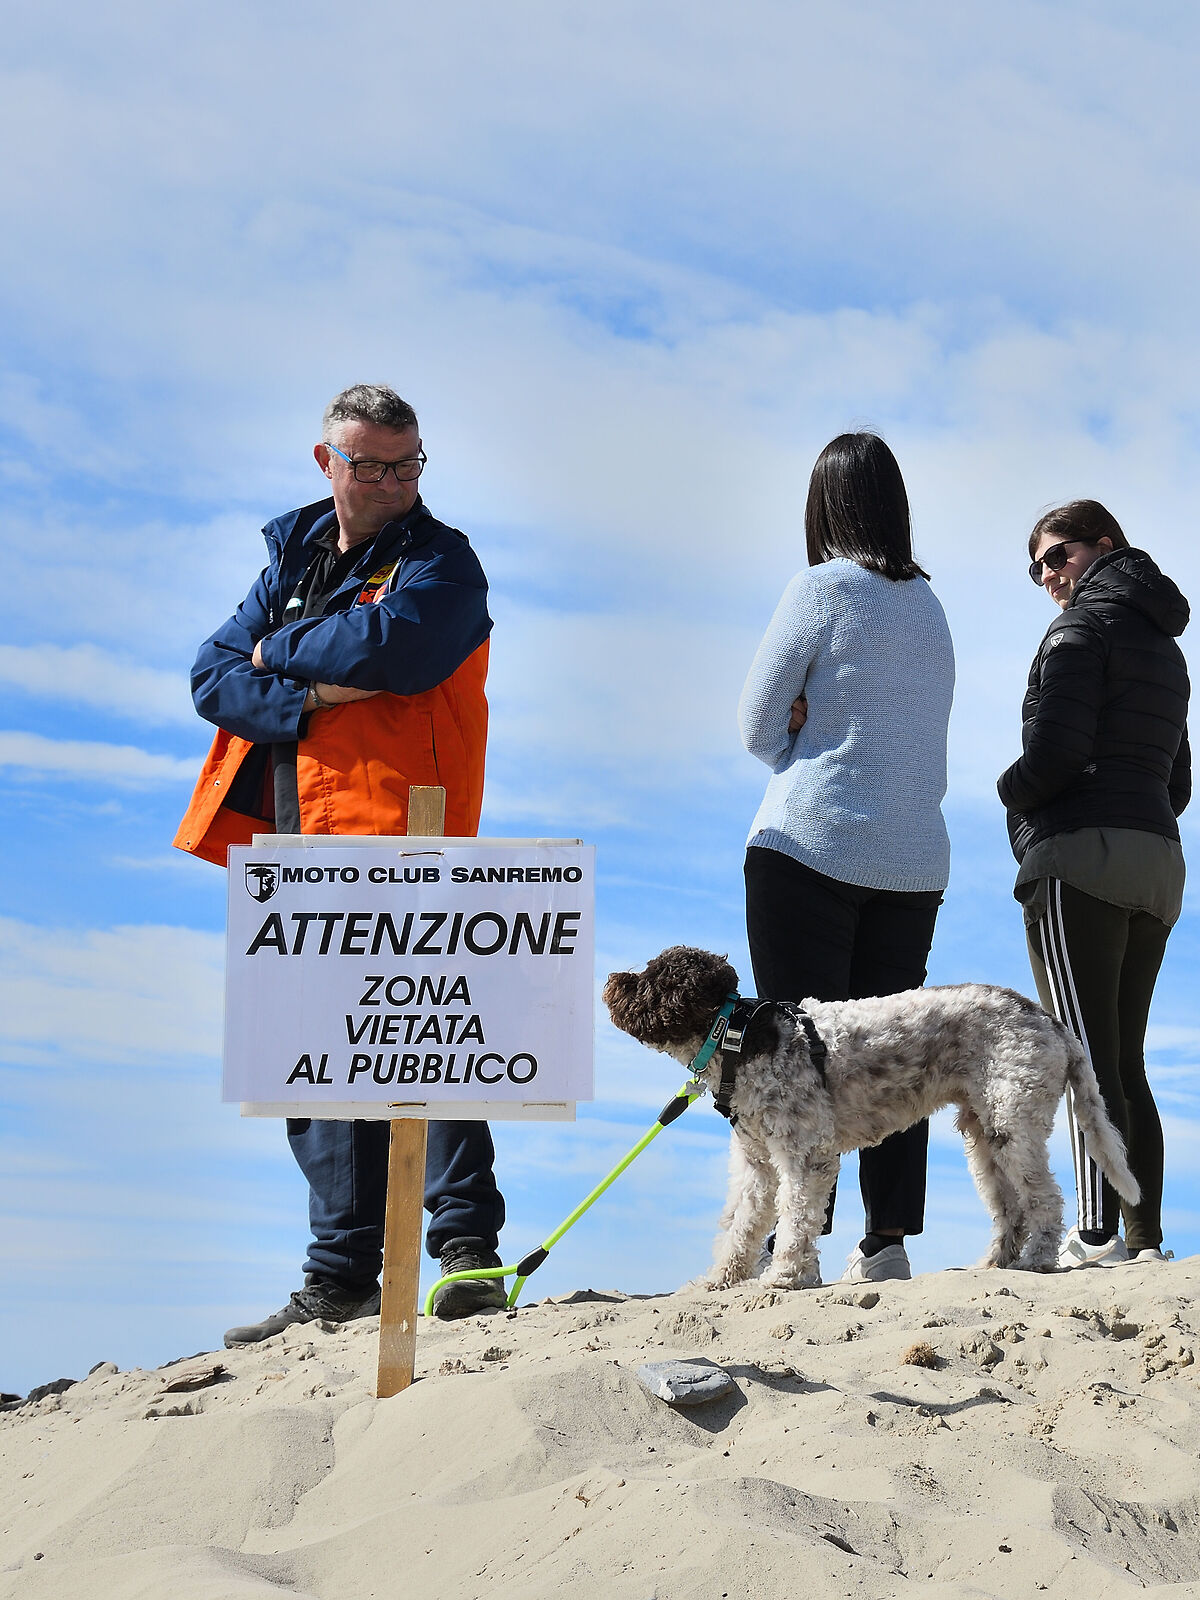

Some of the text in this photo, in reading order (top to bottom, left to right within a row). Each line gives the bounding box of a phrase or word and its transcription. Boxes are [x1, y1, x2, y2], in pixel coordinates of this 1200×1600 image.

[282, 866, 583, 884] MOTO CLUB SANREMO
[245, 912, 581, 956] ATTENZIONE
[358, 975, 472, 1007] ZONA
[345, 1014, 486, 1045] VIETATA
[285, 1052, 538, 1086] AL PUBBLICO
